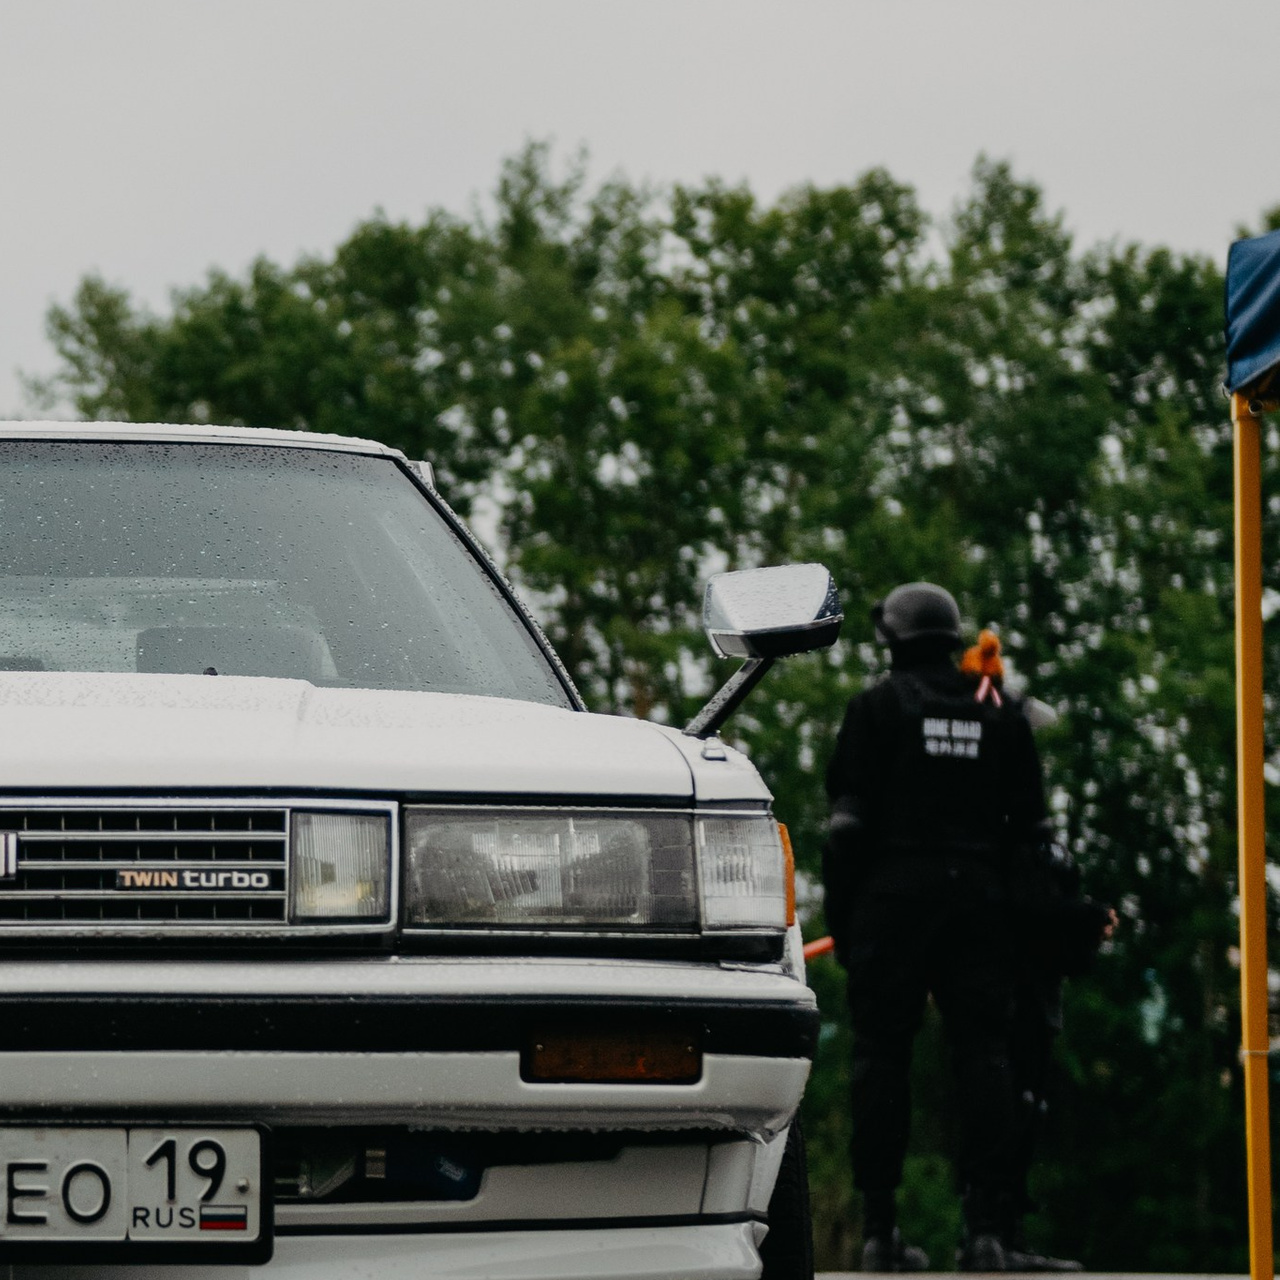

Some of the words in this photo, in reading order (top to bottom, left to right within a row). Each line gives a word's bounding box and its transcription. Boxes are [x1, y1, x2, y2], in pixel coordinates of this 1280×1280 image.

[119, 871, 178, 887] TWIN
[183, 870, 269, 888] turbo
[145, 1140, 227, 1203] 19
[133, 1207, 195, 1228] RUS
